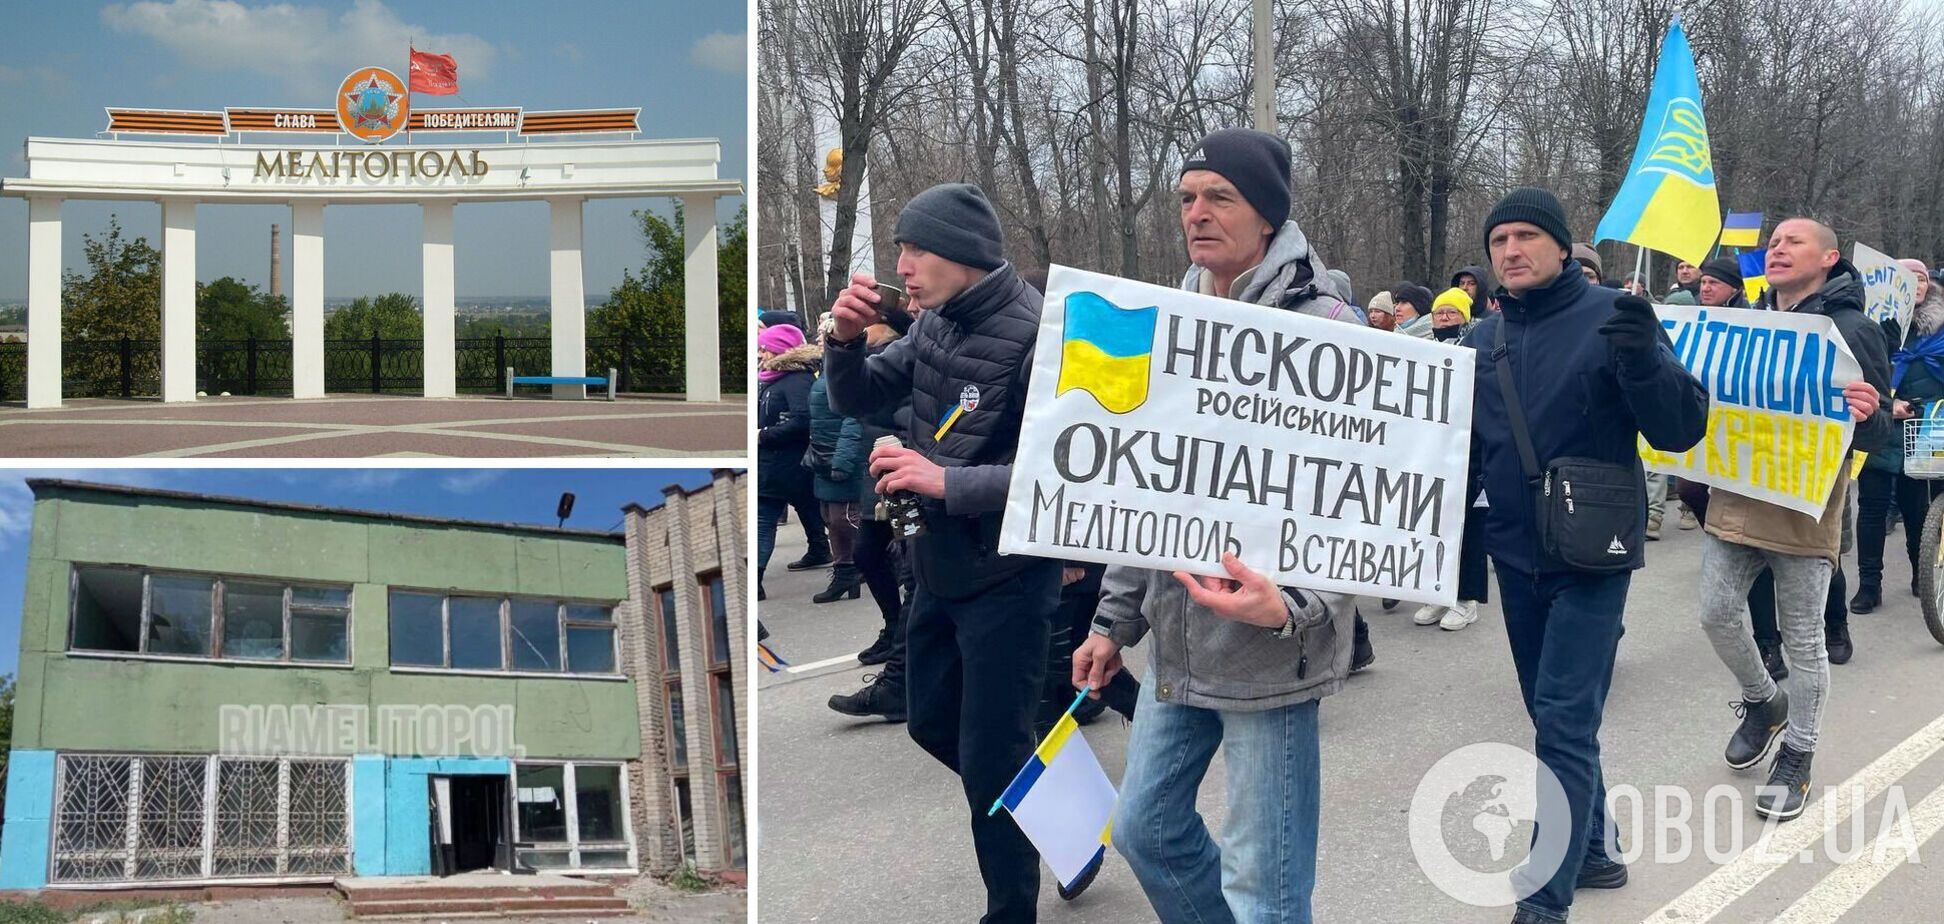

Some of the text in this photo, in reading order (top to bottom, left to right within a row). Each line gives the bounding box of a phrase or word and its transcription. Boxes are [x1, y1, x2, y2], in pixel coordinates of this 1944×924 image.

[274, 113, 515, 128] СЛАВА ПОБЕДИТЕЛЯМ!
[254, 150, 489, 178] МЕЛІТОПОЛЬ
[1163, 314, 1455, 425] НЕСКОРЕНІ
[1053, 422, 1446, 538] ОКУПАНТАМИ
